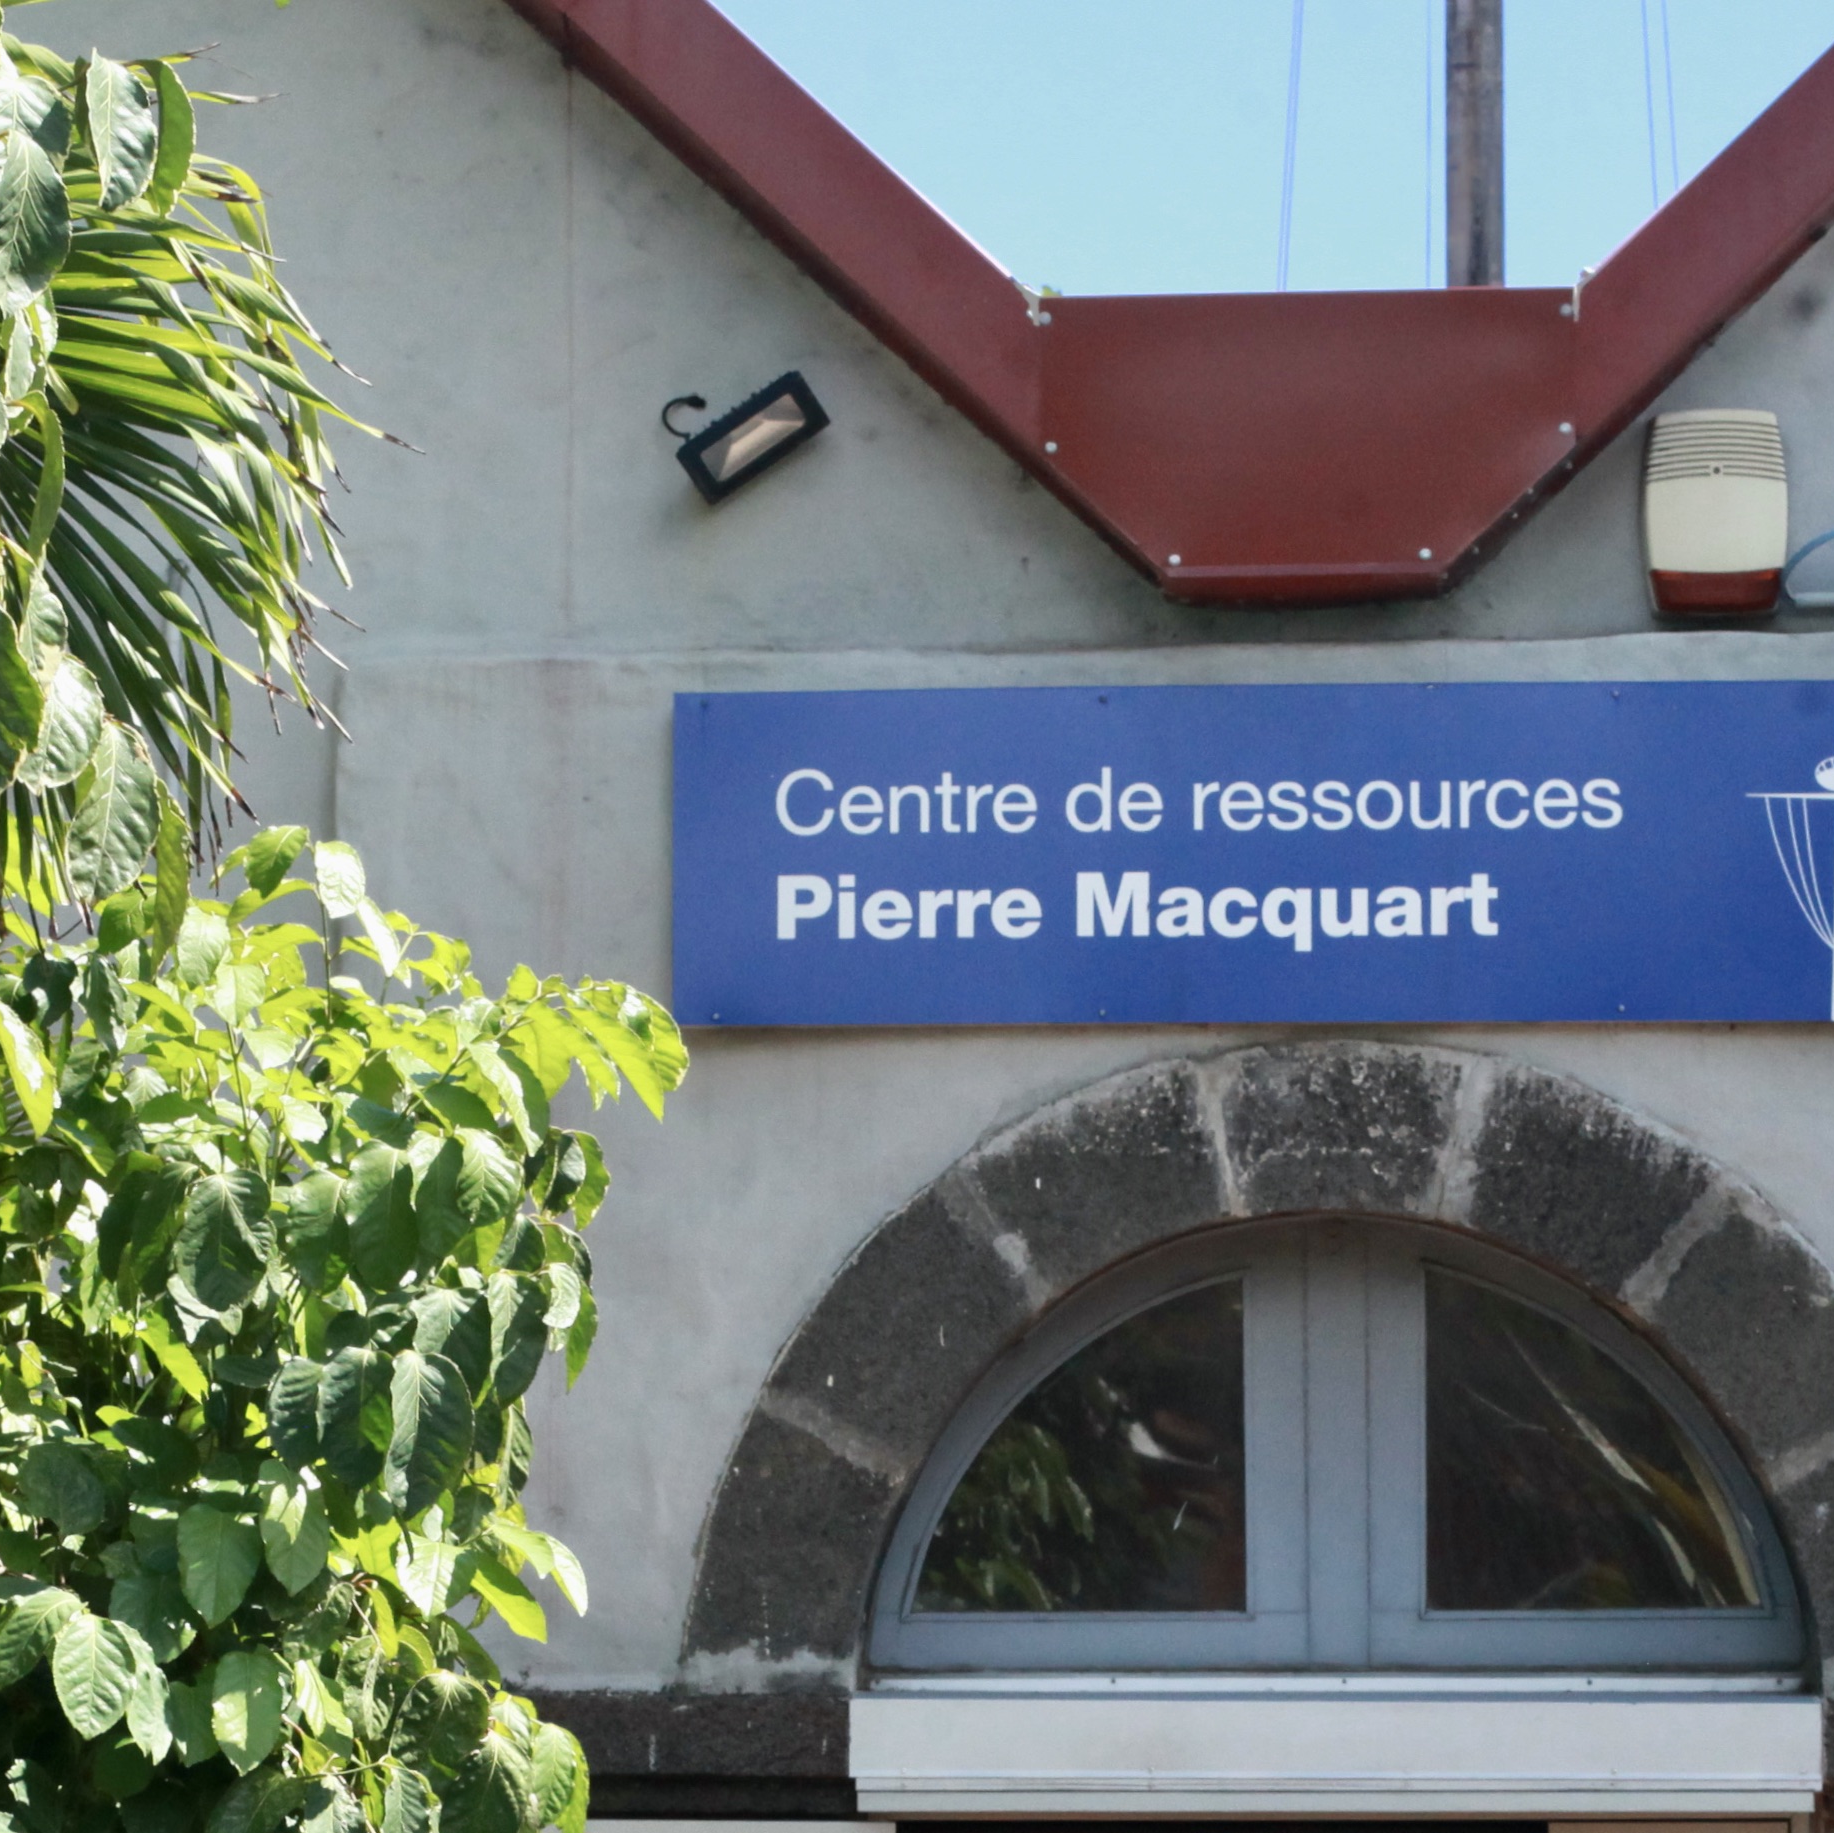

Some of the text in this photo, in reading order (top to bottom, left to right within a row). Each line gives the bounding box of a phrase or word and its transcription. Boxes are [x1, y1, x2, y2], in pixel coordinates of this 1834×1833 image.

[775, 766, 1623, 836] Centre de ressources
[776, 870, 1499, 952] Pierre Macquart
